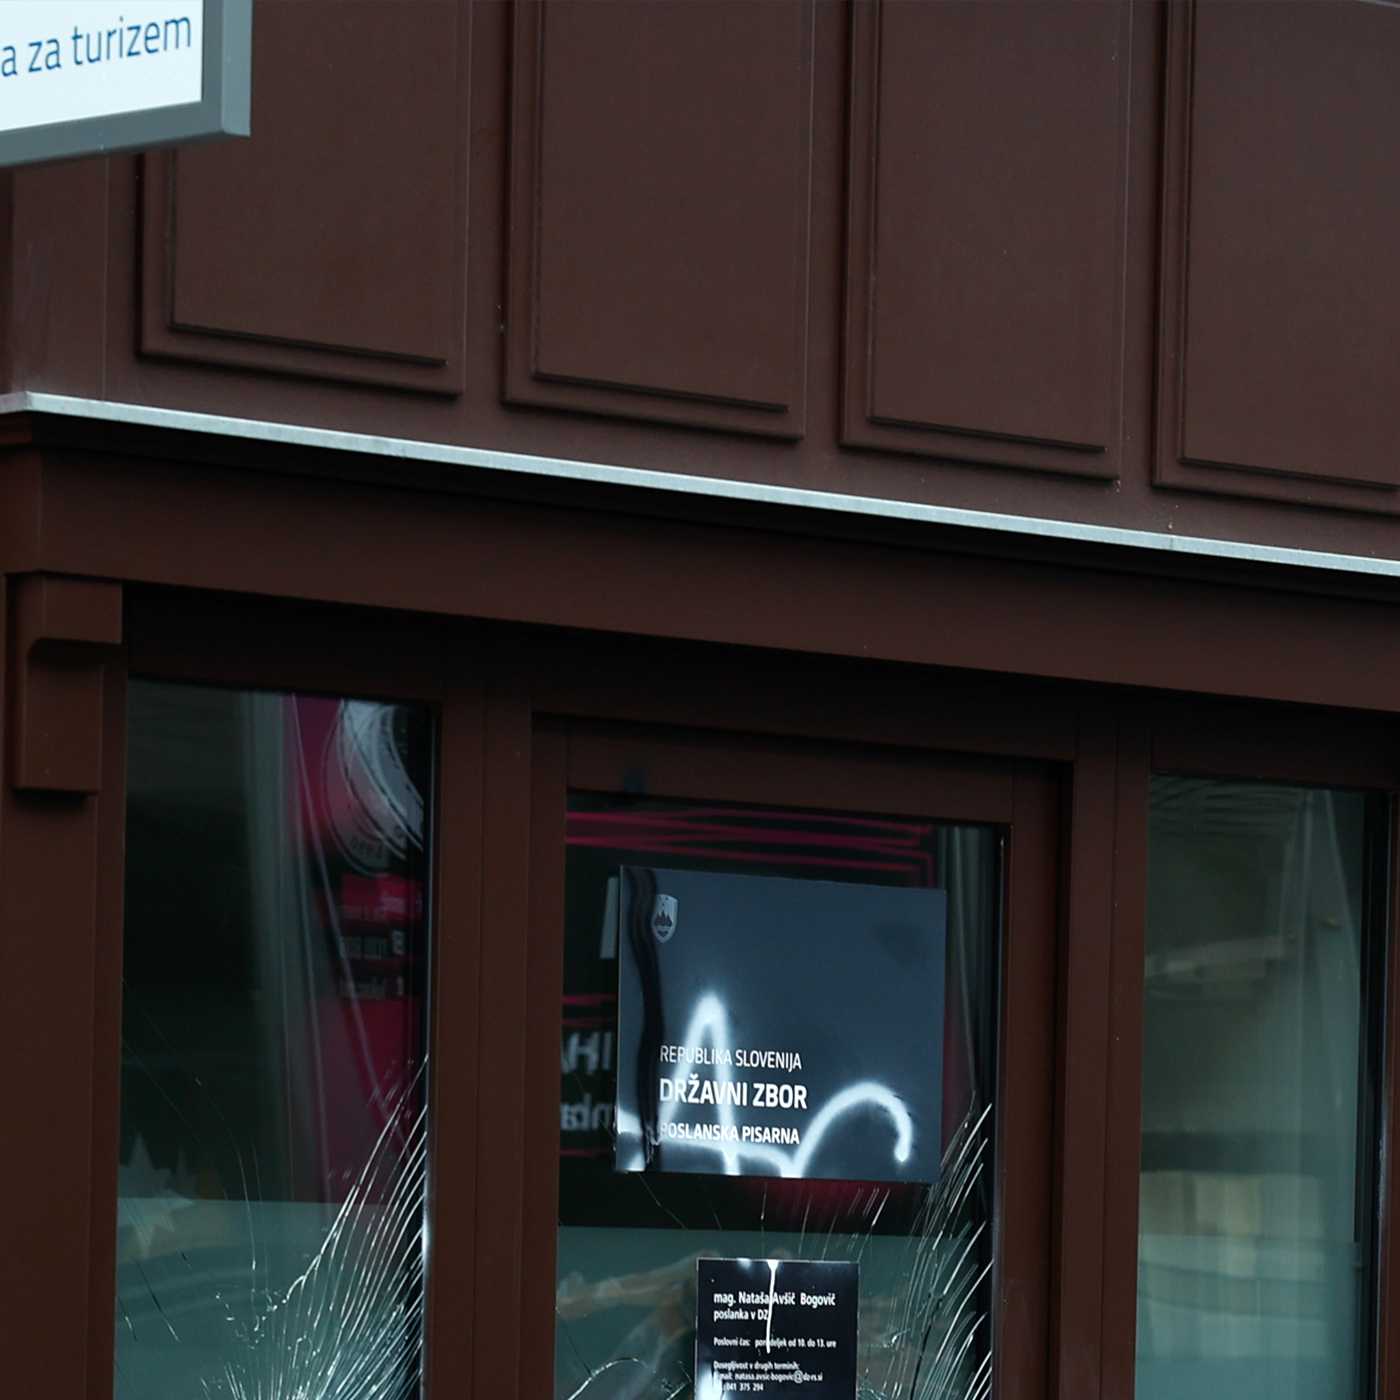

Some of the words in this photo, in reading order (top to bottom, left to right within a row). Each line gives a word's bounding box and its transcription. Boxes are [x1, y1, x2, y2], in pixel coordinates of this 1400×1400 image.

[28, 38, 62, 73] za
[71, 16, 192, 66] turizem
[660, 1045, 733, 1066] REPUBLIKA
[735, 1049, 803, 1073] SLOVENIJA
[659, 1073, 748, 1107] DRŽAVNI
[752, 1082, 808, 1109] ZBOR
[660, 1122, 740, 1142] POSLANSKA
[742, 1126, 800, 1145] PISARNA
[713, 1293, 737, 1307] mag.
[738, 1291, 770, 1304] Nataša
[800, 1292, 836, 1309] Bogovič
[713, 1308, 749, 1322] poslanka
[750, 1311, 756, 1320] v
[755, 1337, 787, 1349] pondeljek
[807, 1338, 816, 1347] do
[826, 1340, 837, 1348] ure
